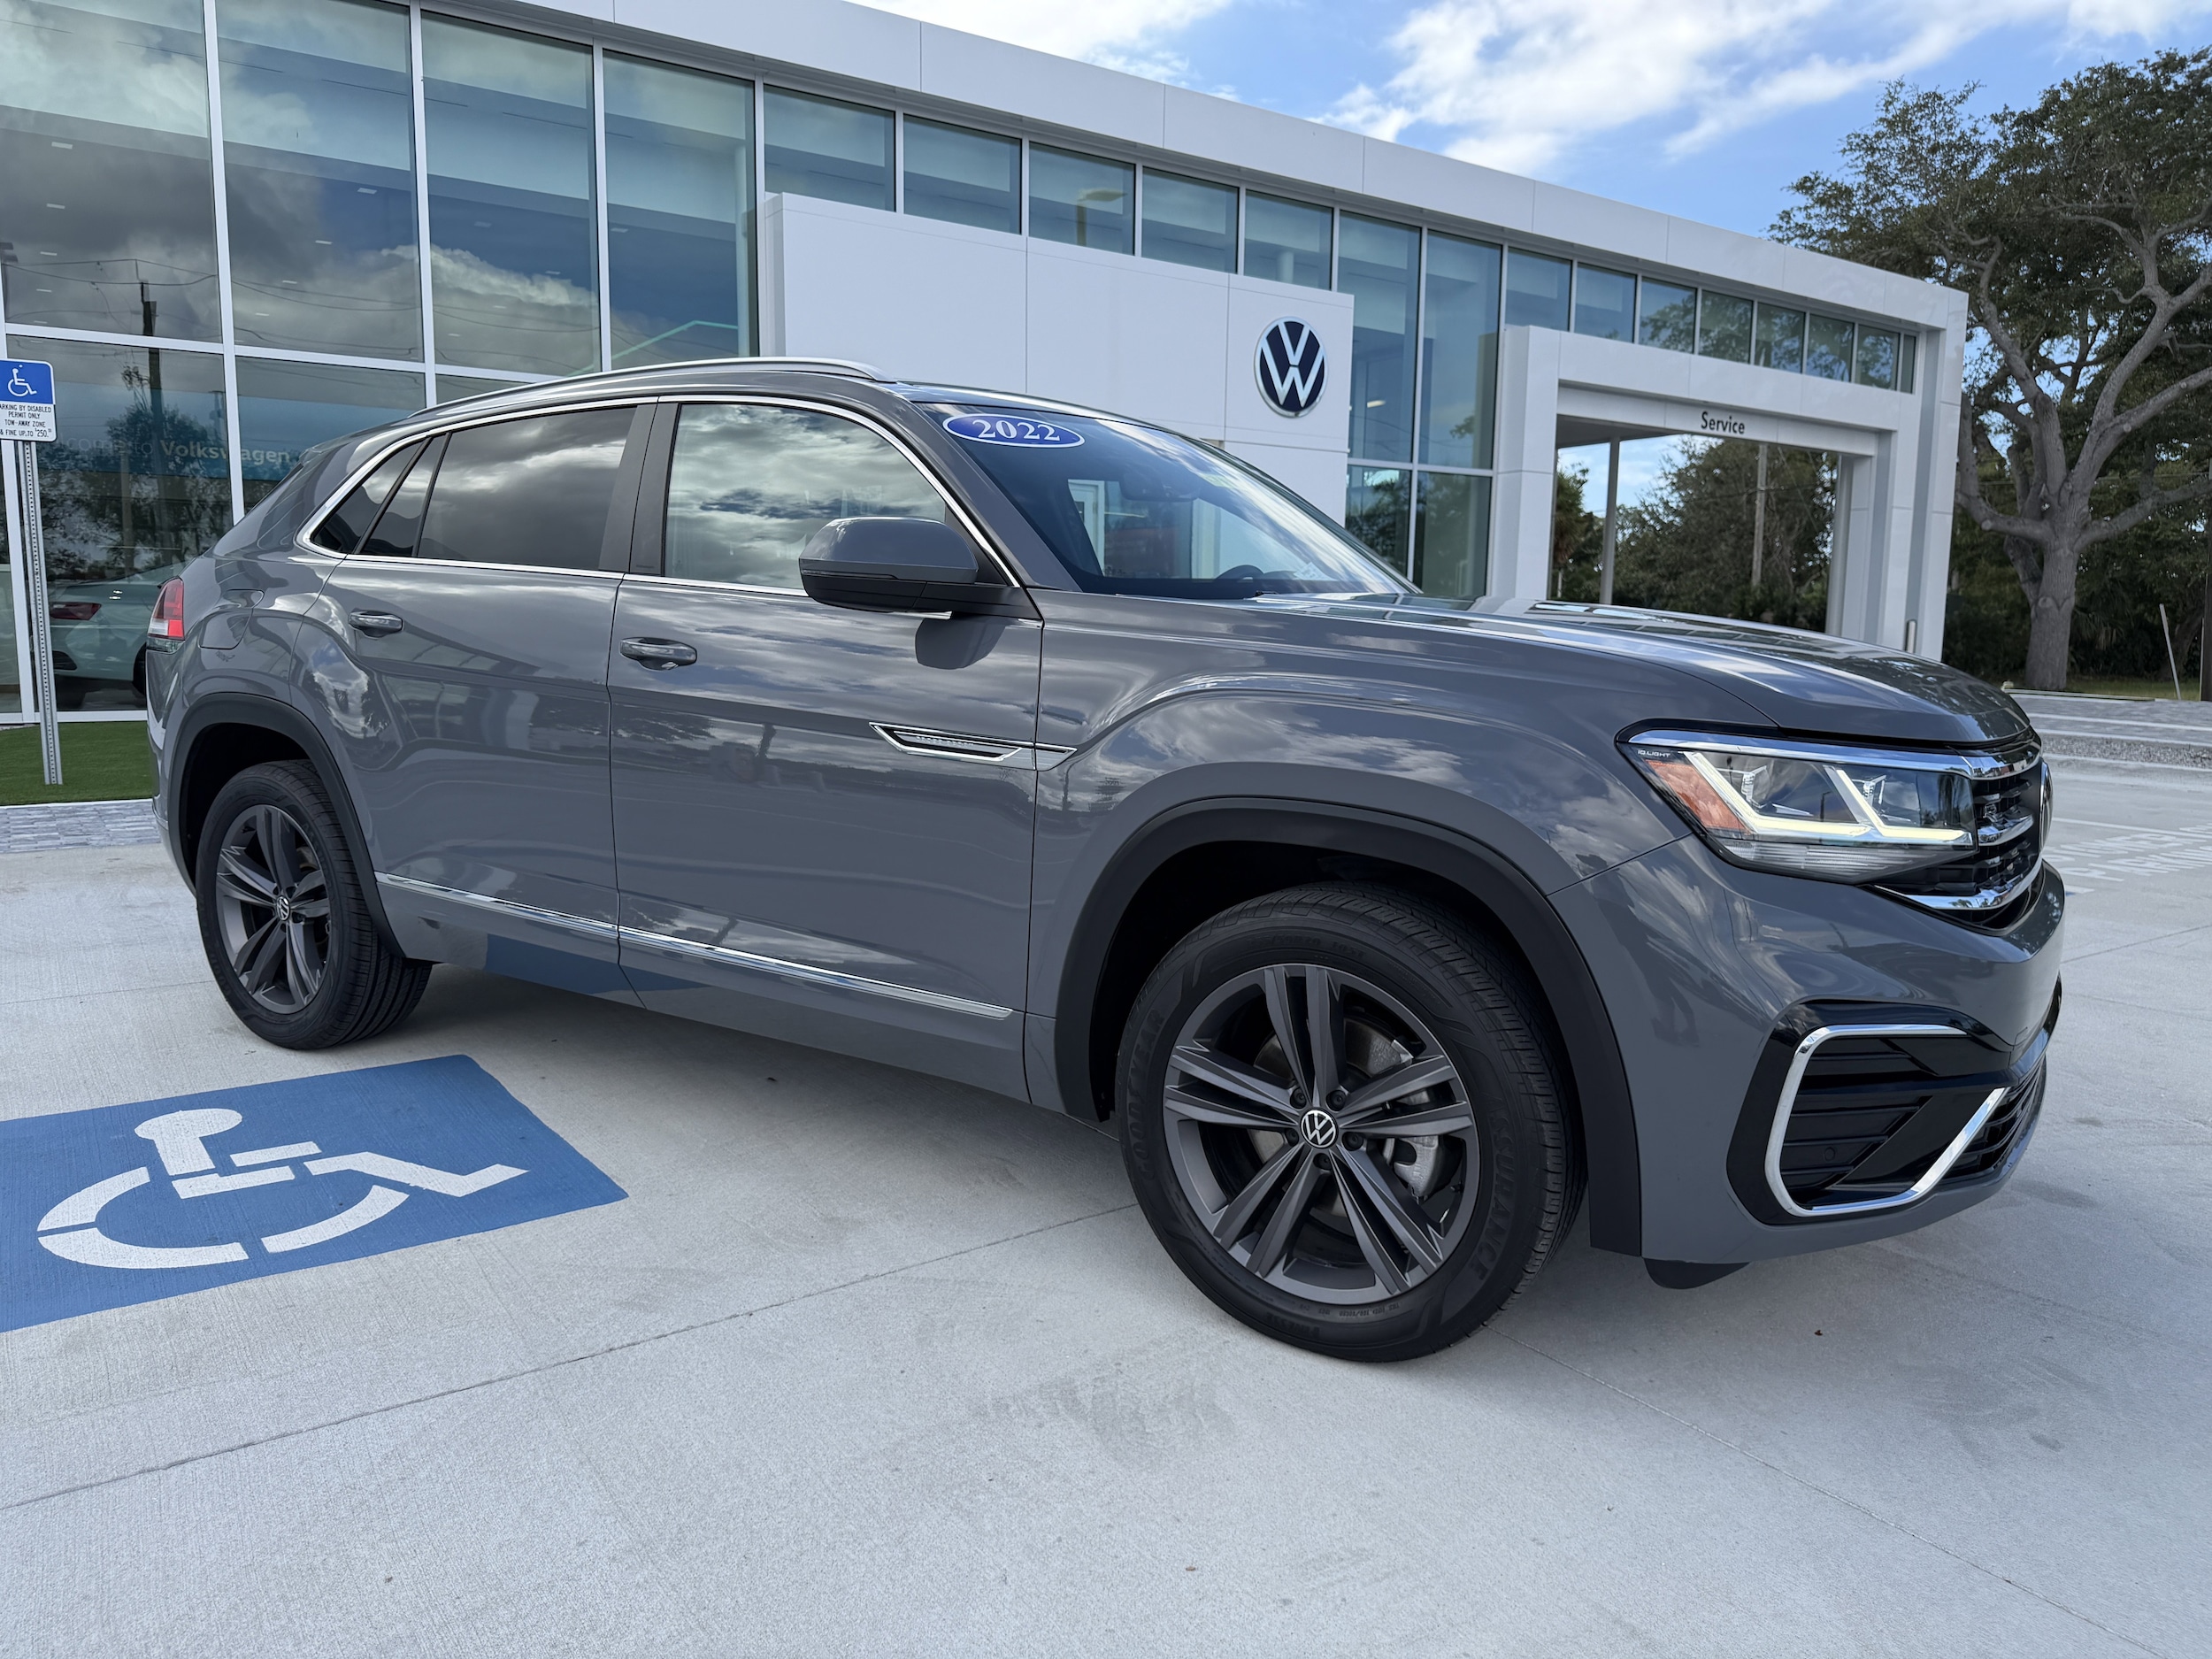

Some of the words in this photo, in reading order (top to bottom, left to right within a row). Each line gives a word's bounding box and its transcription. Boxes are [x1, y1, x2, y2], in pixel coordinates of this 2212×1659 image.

[1257, 319, 1326, 413] VW
[972, 419, 1061, 442] 2022
[1701, 411, 1746, 434] Service
[1125, 1008, 1165, 1182] GOODYEAR
[1469, 1091, 1516, 1282] ASSURANCE
